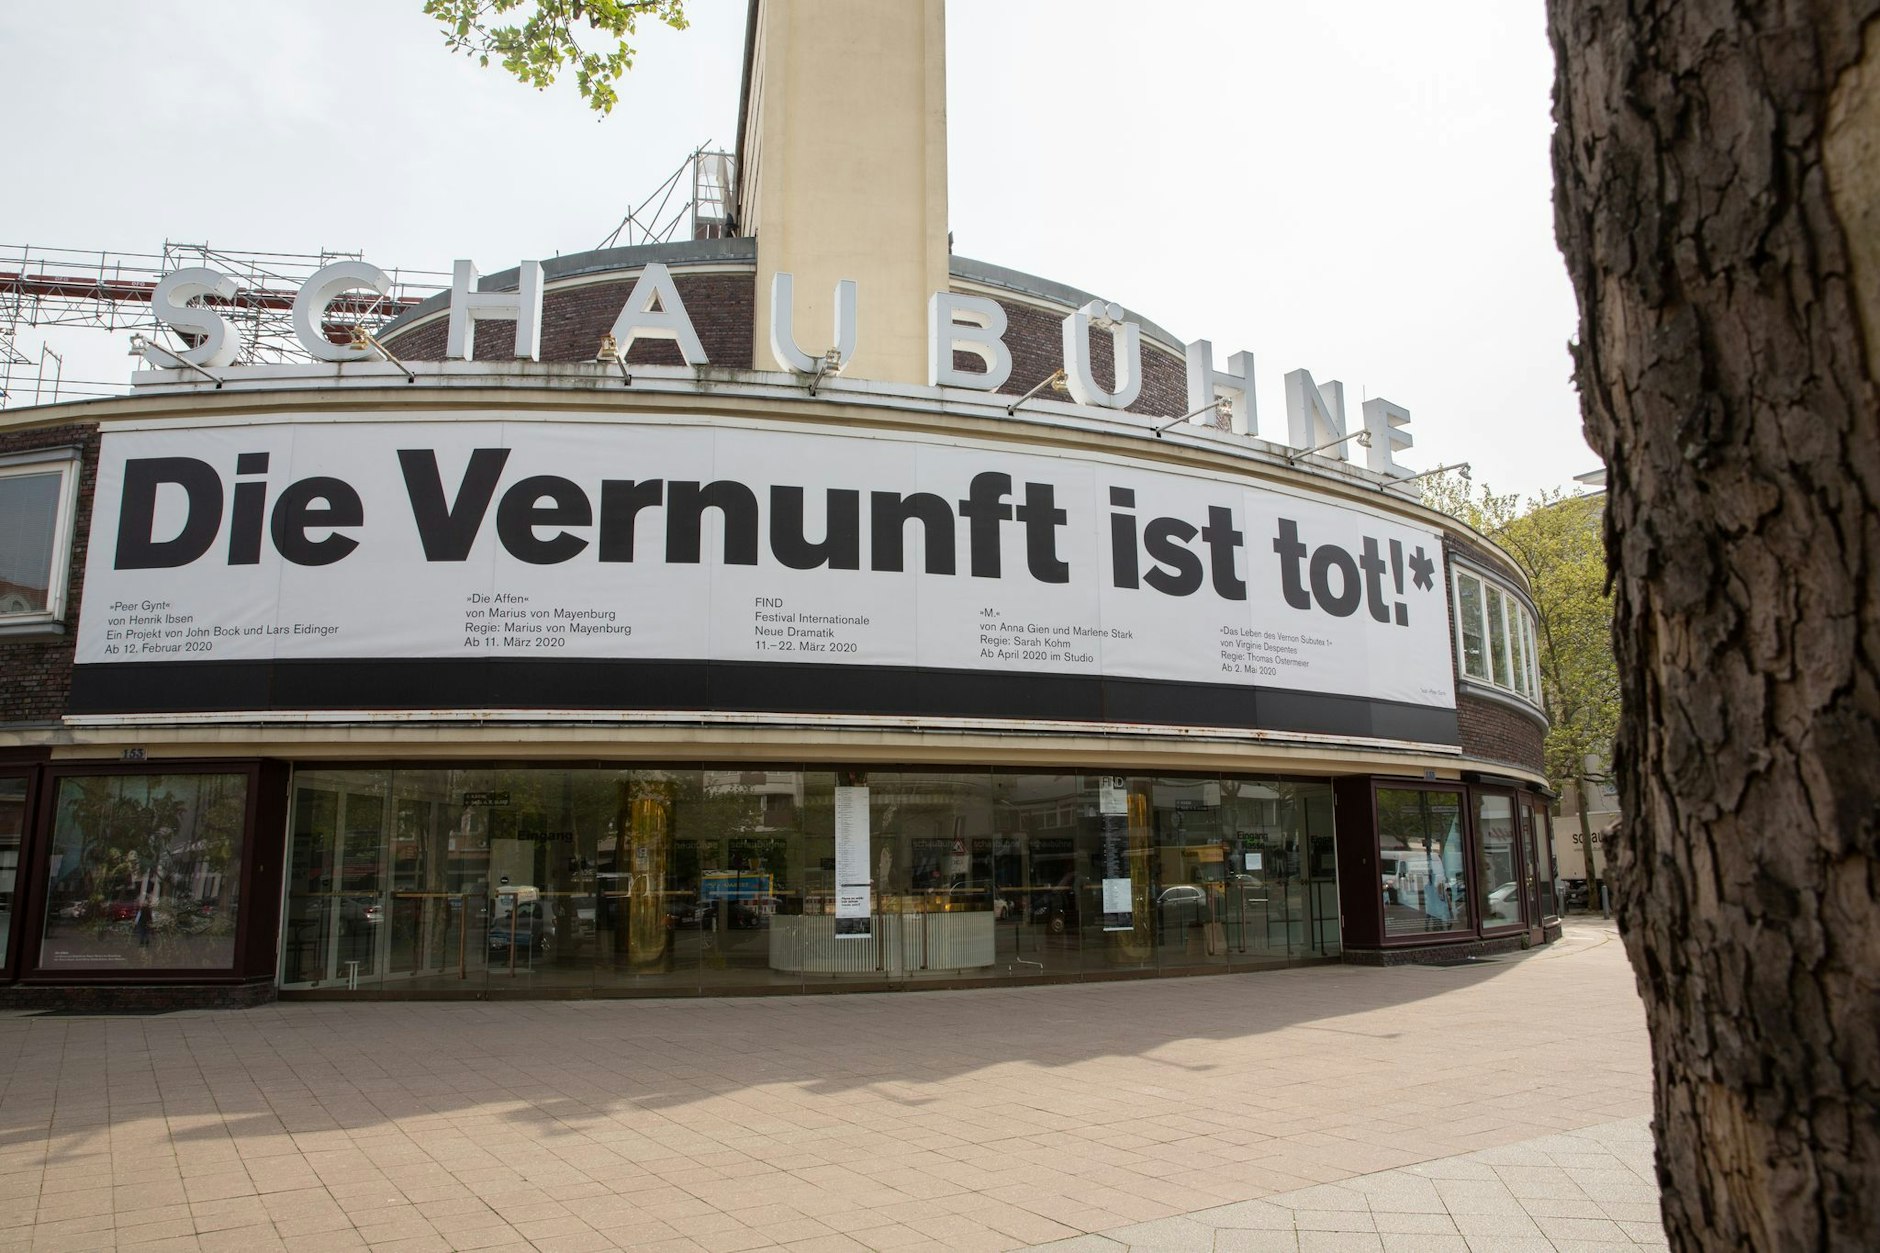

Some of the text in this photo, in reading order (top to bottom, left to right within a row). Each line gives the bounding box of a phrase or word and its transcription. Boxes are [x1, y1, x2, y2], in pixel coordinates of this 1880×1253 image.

[144, 259, 1416, 479] SCHAUBÜHNE
[114, 452, 363, 570] Die
[397, 448, 1068, 583] Vernunft
[1110, 486, 1247, 601] ist
[755, 597, 783, 608] FIND
[108, 613, 193, 626] von Henrik Ibsen
[465, 607, 616, 621] von Marius von Mayenburg
[755, 611, 870, 625] Festival Internationale
[106, 623, 339, 641] Ein Projekt von John Bock und Lars Eidinger
[465, 622, 632, 636] Regie: Marius von Mayenburg
[755, 626, 835, 637] Neue Dramatik
[980, 622, 1133, 639] von Anna Gien und Marlene Stark
[104, 641, 213, 654] Ab 12. Februar 2020
[464, 637, 565, 647] Ab 11. März 2020
[799, 641, 825, 652] März
[830, 642, 857, 653] 2020
[980, 635, 1071, 648] Regie: Sarah Kohm
[980, 648, 1094, 663] Ab April 2020 im Studio
[518, 830, 573, 843] Eingang
[1237, 831, 1269, 842] Eingang
